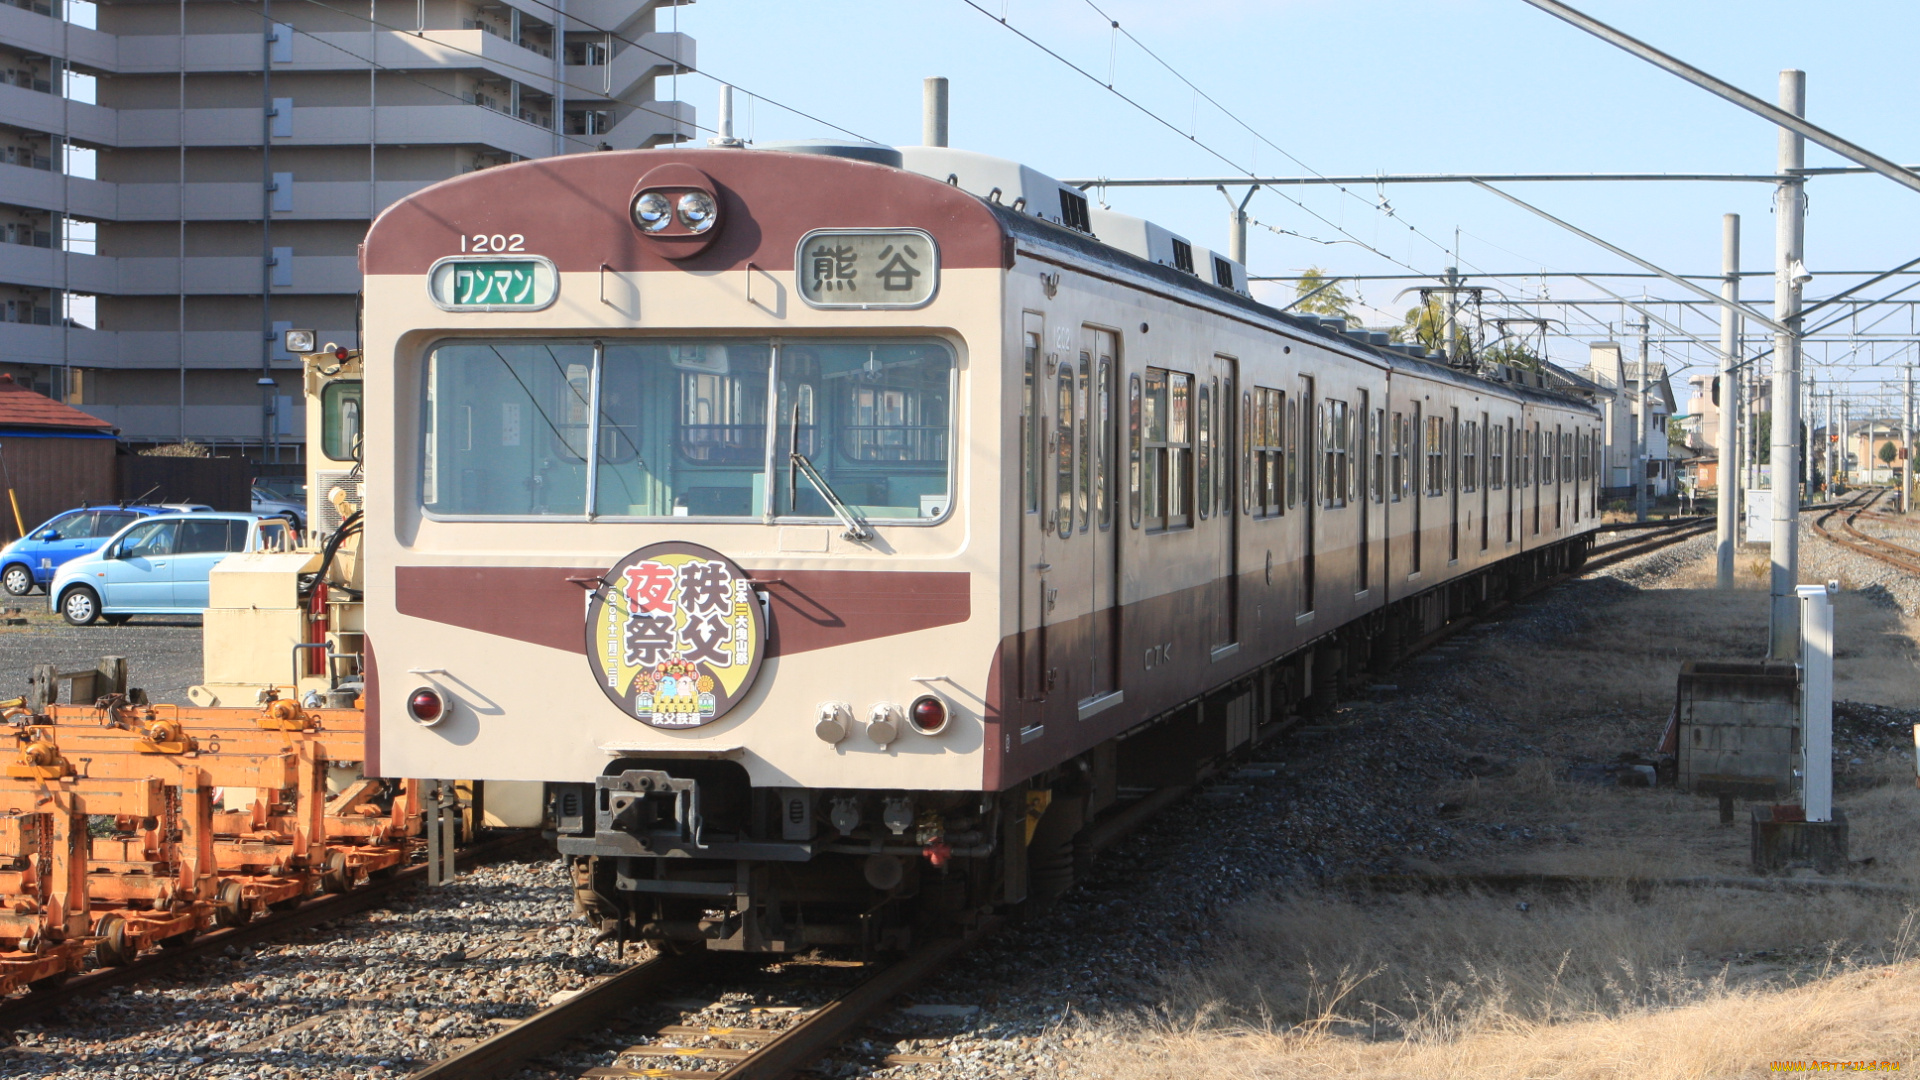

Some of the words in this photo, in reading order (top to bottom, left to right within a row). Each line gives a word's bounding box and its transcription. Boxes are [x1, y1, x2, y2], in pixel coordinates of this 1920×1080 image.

[460, 234, 525, 253] 1202
[812, 244, 921, 292] 熊谷
[456, 270, 532, 303] ワンマン
[1143, 642, 1171, 671] CTK
[651, 712, 701, 725] 秩父鉄道
